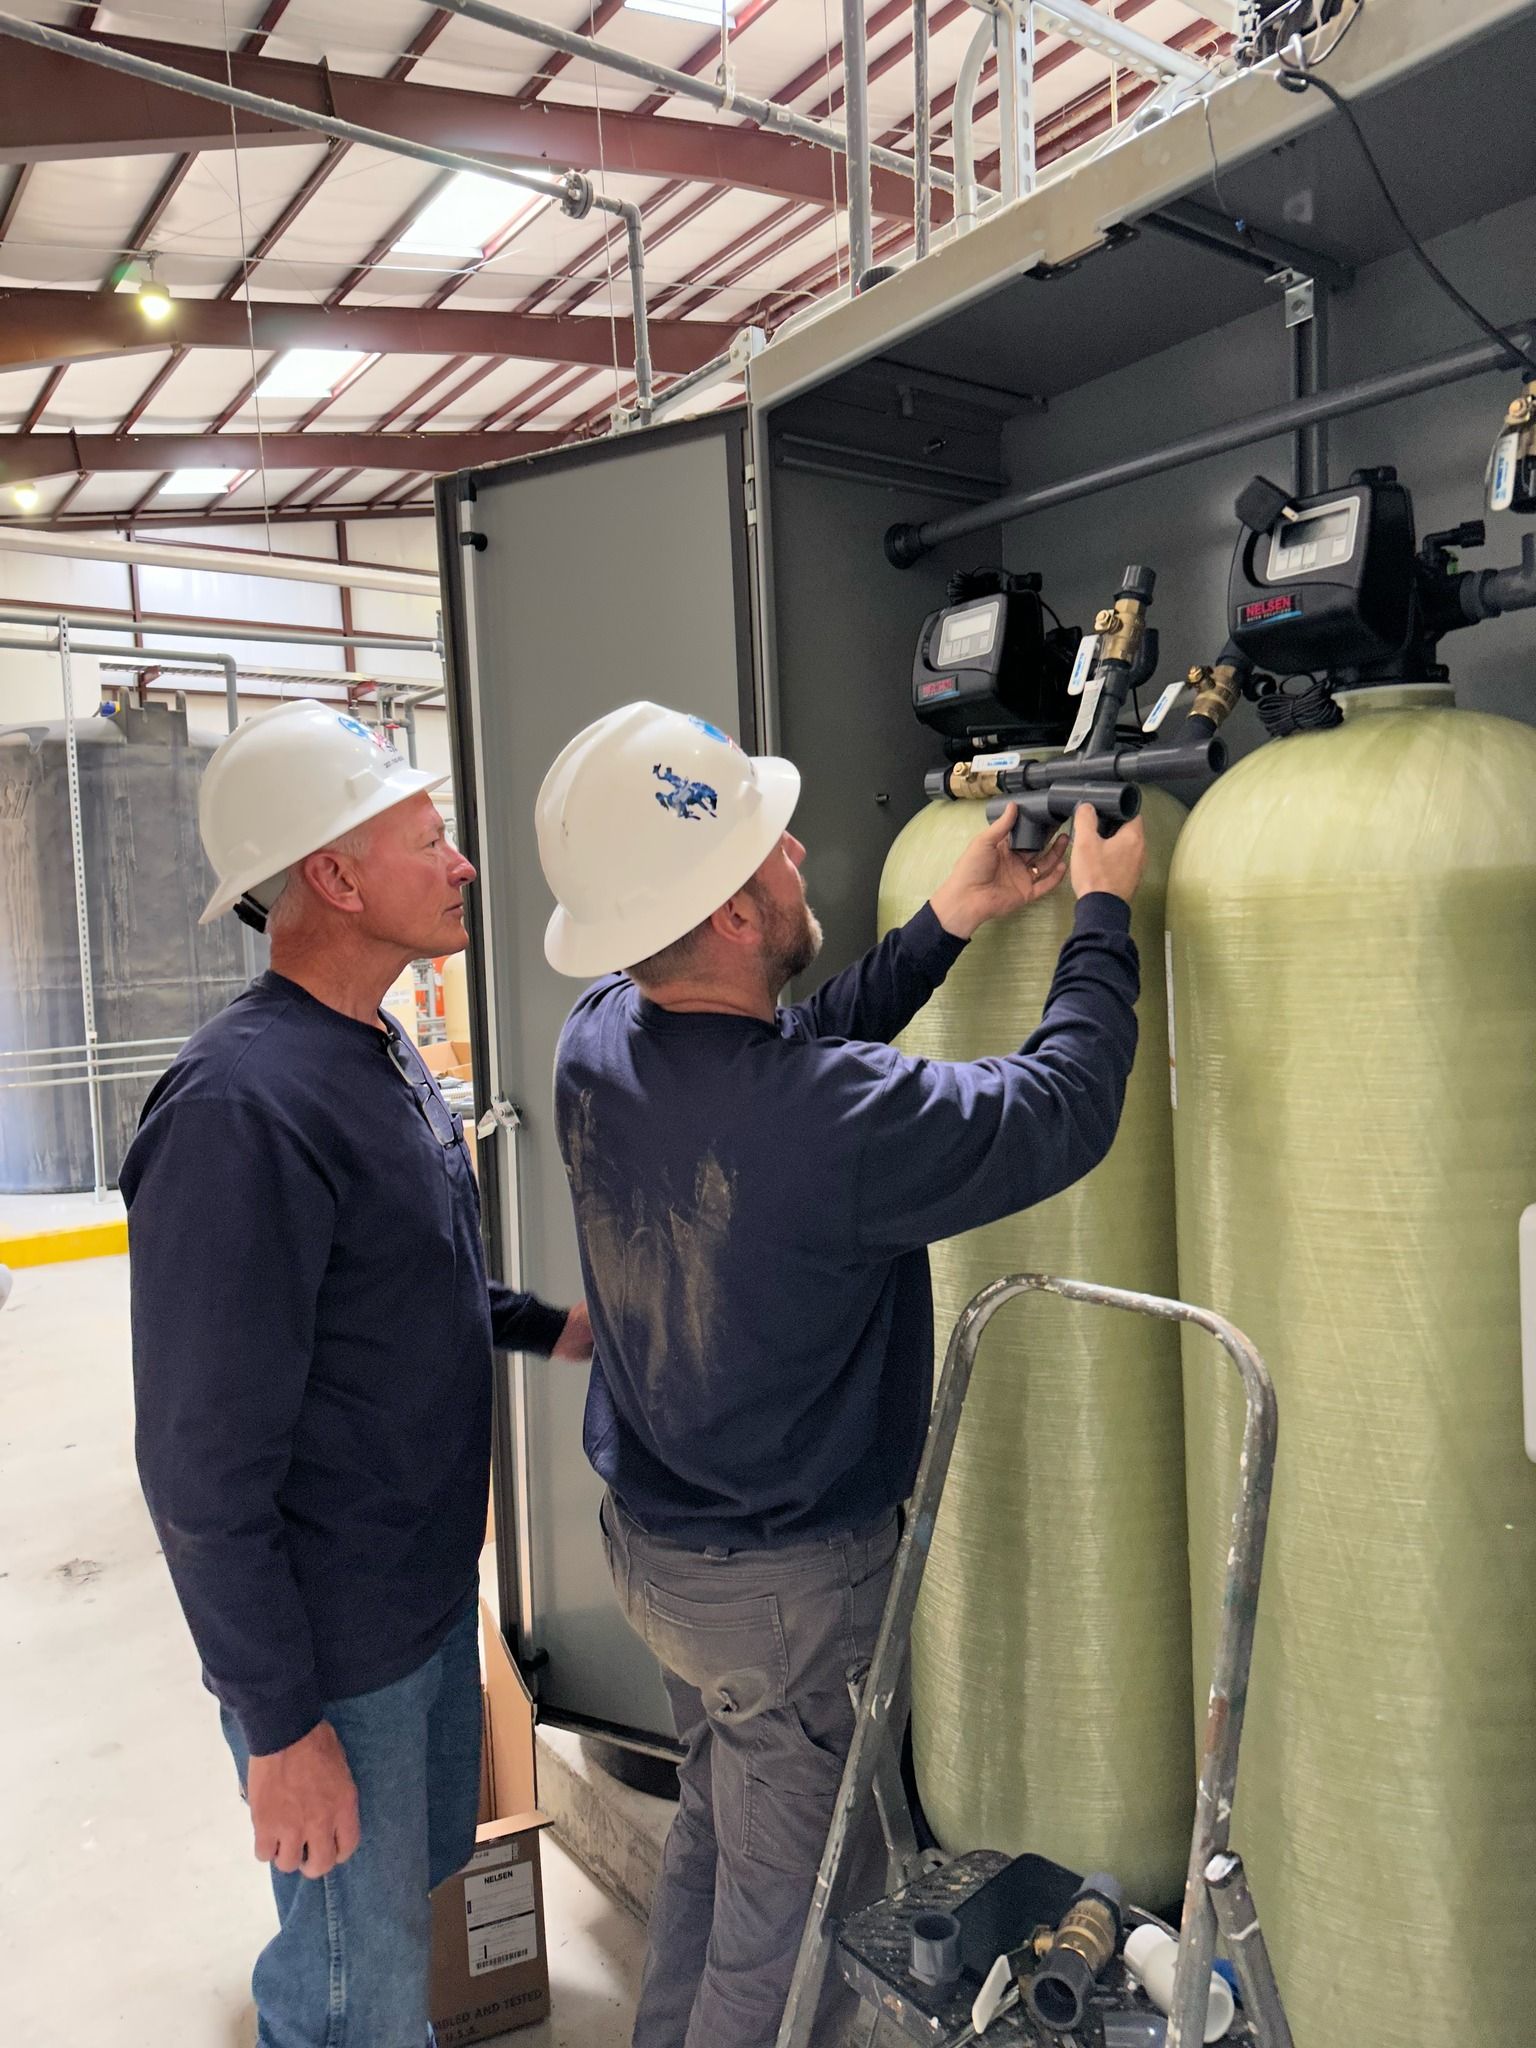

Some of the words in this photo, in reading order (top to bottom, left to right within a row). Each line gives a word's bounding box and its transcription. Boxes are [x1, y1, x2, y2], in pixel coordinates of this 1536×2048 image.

[1246, 595, 1292, 618] NELSEN
[484, 1870, 513, 1884] NELSEN
[474, 2002, 500, 2020] AND
[503, 1989, 543, 2010] TESTED
